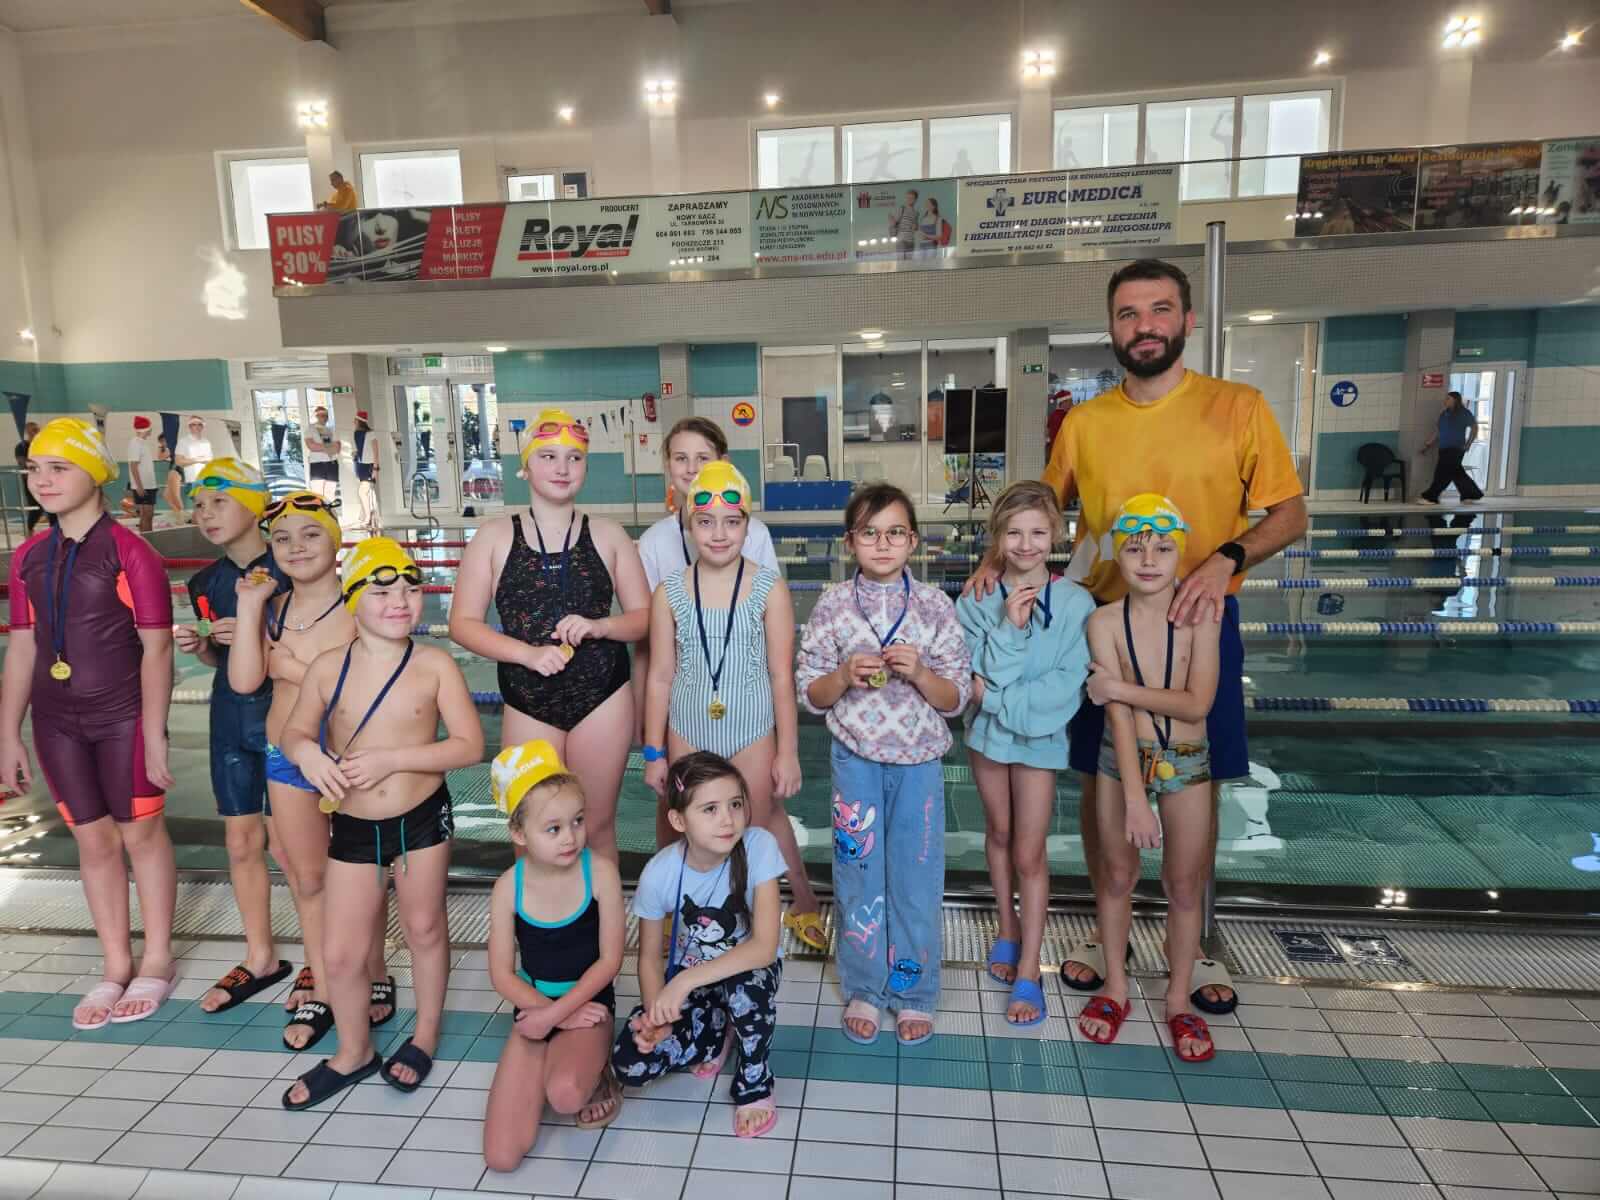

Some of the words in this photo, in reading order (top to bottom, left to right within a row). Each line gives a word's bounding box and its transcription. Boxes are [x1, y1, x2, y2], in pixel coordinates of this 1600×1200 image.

[1022, 184, 1142, 206] EUROMEDICA
[600, 204, 640, 213] PRODUCENT
[668, 201, 729, 212] ZAPRASZAMY
[979, 218, 1030, 229] CENTRUM
[276, 223, 325, 247] PLISY
[519, 214, 640, 258] Royal
[970, 229, 1043, 241] REHABILITACJI
[275, 251, 328, 275] -30%
[532, 263, 609, 274] www.royal.org.pl
